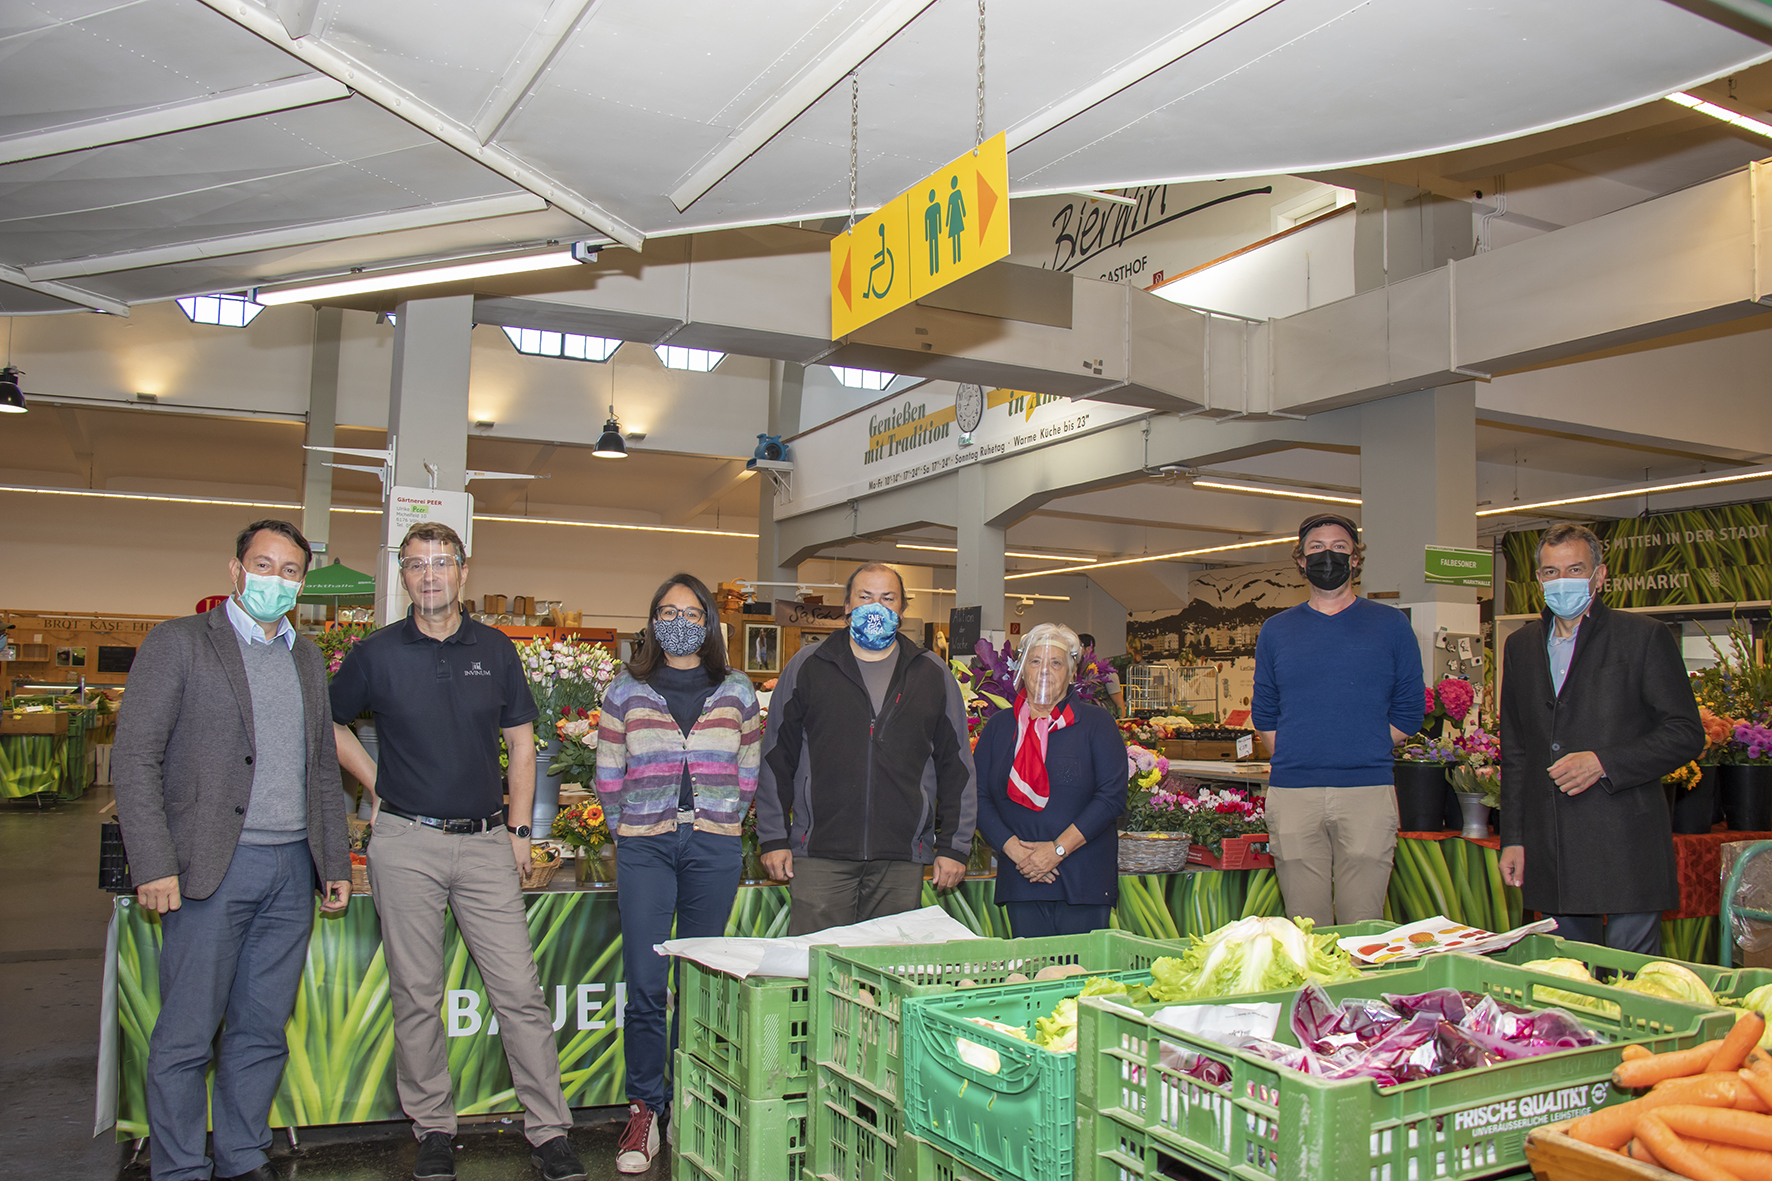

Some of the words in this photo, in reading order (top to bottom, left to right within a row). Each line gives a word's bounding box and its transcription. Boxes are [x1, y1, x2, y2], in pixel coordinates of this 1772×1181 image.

[868, 401, 927, 439] Genießen
[864, 440, 885, 466] mit
[887, 420, 950, 458] Tradition
[955, 450, 979, 465] Sonntag
[980, 442, 1006, 457] Ruhetag
[1014, 434, 1037, 447] Warme
[1040, 424, 1062, 440] Küche
[1063, 420, 1075, 432] bis
[397, 496, 426, 505] Gärtnerei
[412, 505, 426, 513] Peer
[1613, 533, 1662, 551] MITTEN
[1666, 531, 1681, 545] IN
[1685, 529, 1715, 543] DER
[1719, 524, 1769, 541] STADT
[1440, 558, 1477, 569] FALBESONER
[1597, 573, 1690, 593] ERNMARKT
[44, 619, 81, 630] BROT
[1454, 1100, 1518, 1131] FRISCHE
[1519, 1084, 1589, 1117] QUALITÄT
[1472, 1114, 1549, 1138] UNVERÄUSSERLICHE
[1551, 1106, 1593, 1123] LEIHSTEIGE
